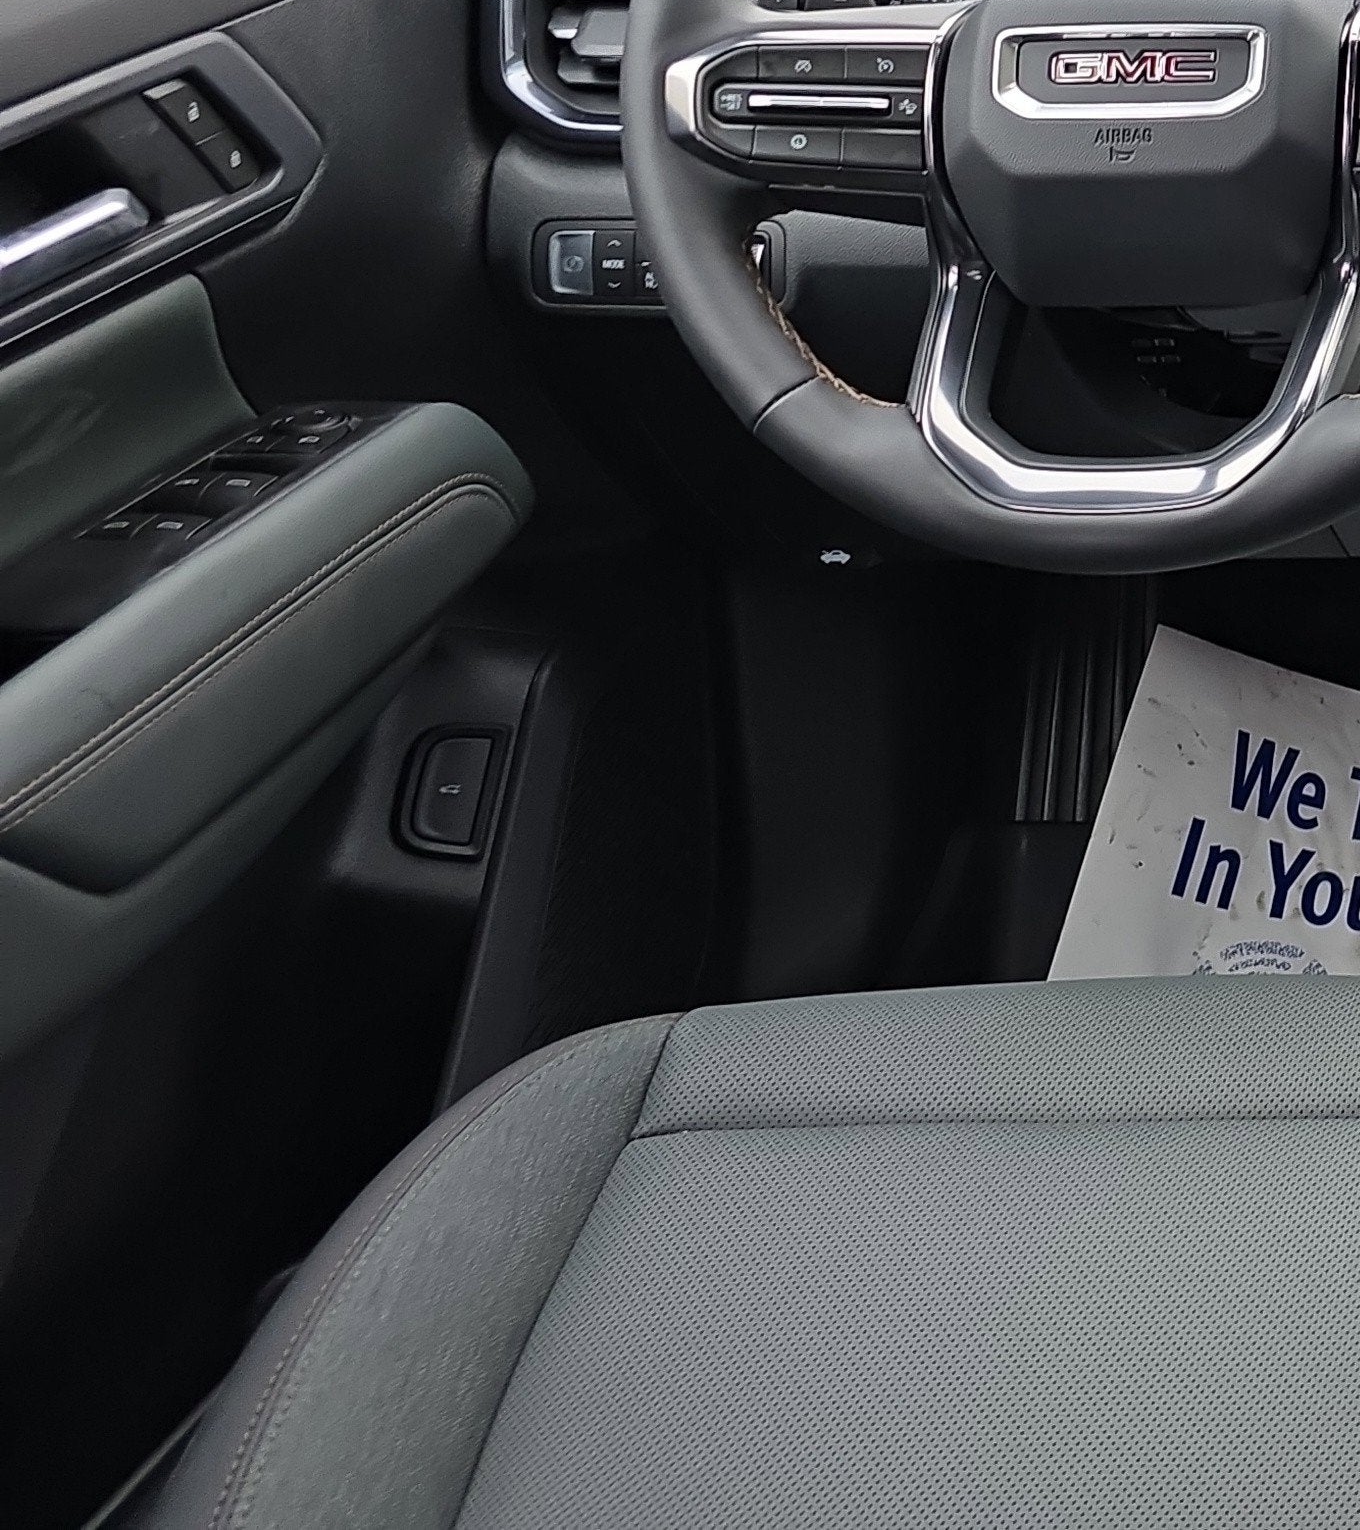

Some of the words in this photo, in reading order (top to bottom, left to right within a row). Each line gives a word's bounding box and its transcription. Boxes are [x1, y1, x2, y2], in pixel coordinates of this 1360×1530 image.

[1050, 51, 1216, 84] GMC
[1095, 128, 1153, 144] AIRBAG
[1230, 729, 1326, 829] We
[1171, 817, 1242, 910] In
